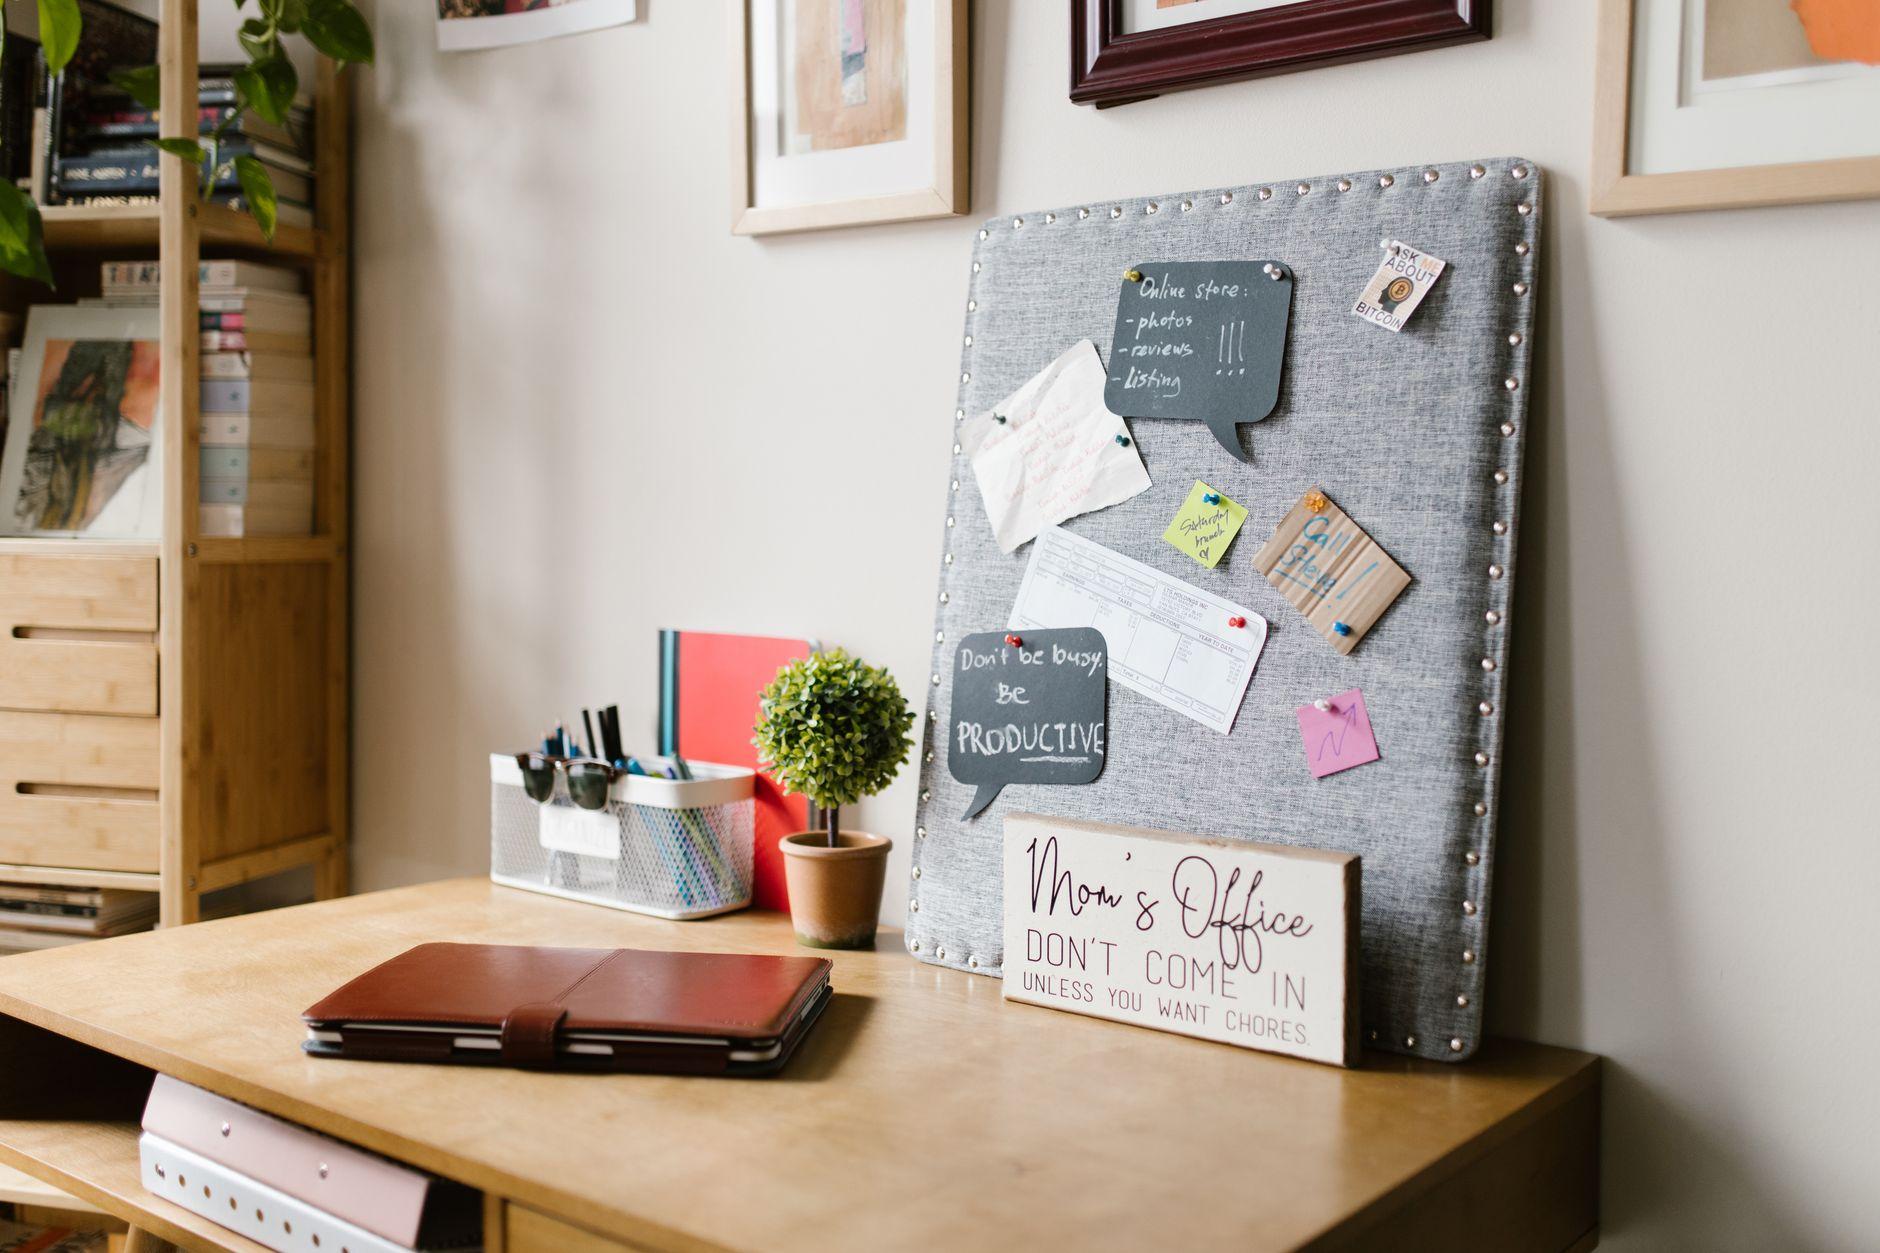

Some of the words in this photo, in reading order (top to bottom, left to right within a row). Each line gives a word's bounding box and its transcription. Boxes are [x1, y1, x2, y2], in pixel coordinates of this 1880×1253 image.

[1385, 257, 1436, 285] ABOUT
[1139, 273, 1186, 299] Online
[1195, 280, 1248, 300] store:
[1356, 301, 1403, 329] BITCOIN
[1303, 516, 1352, 555] Call
[1150, 611, 1181, 629] DEDUCTIONS
[961, 648, 1009, 671] Don't
[1019, 647, 1044, 665] be
[1220, 644, 1234, 654] DATE
[957, 721, 1104, 756] PRODUCTIVE
[1027, 836, 1159, 931] Mom's
[1172, 855, 1313, 973] Office
[1027, 928, 1118, 976] DON'T
[1146, 950, 1238, 1000] COME
[1272, 971, 1306, 1012] IN
[1023, 971, 1094, 1003] UNLESS
[1108, 987, 1142, 1013] YOU
[1158, 997, 1211, 1025] WANT
